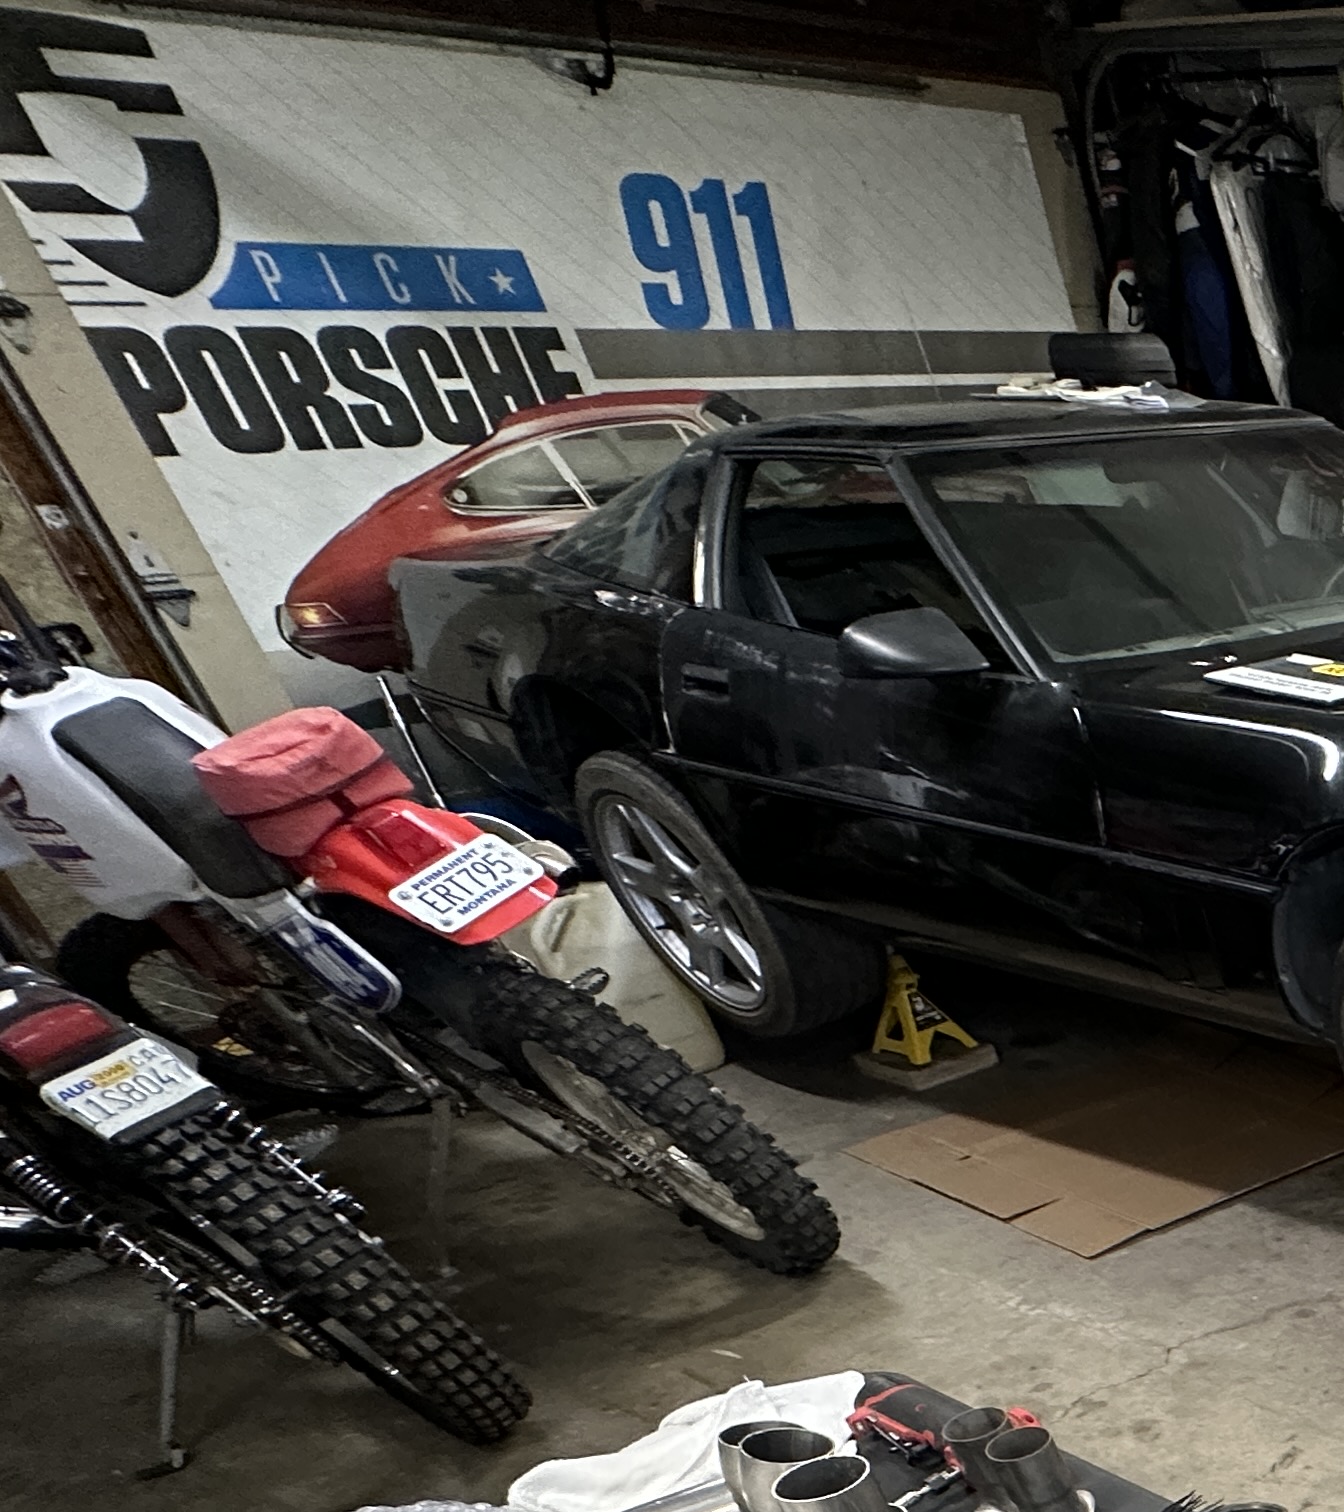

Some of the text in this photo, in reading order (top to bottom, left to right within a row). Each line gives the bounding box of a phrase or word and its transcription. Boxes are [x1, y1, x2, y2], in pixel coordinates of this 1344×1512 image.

[619, 172, 795, 331] 911
[259, 258, 476, 306] PICK
[86, 325, 584, 457] PORSCHE
[410, 847, 480, 891] PERMANENT
[416, 852, 514, 914] ERT795
[456, 878, 518, 916] MONTANA
[57, 1079, 97, 1102] AUG
